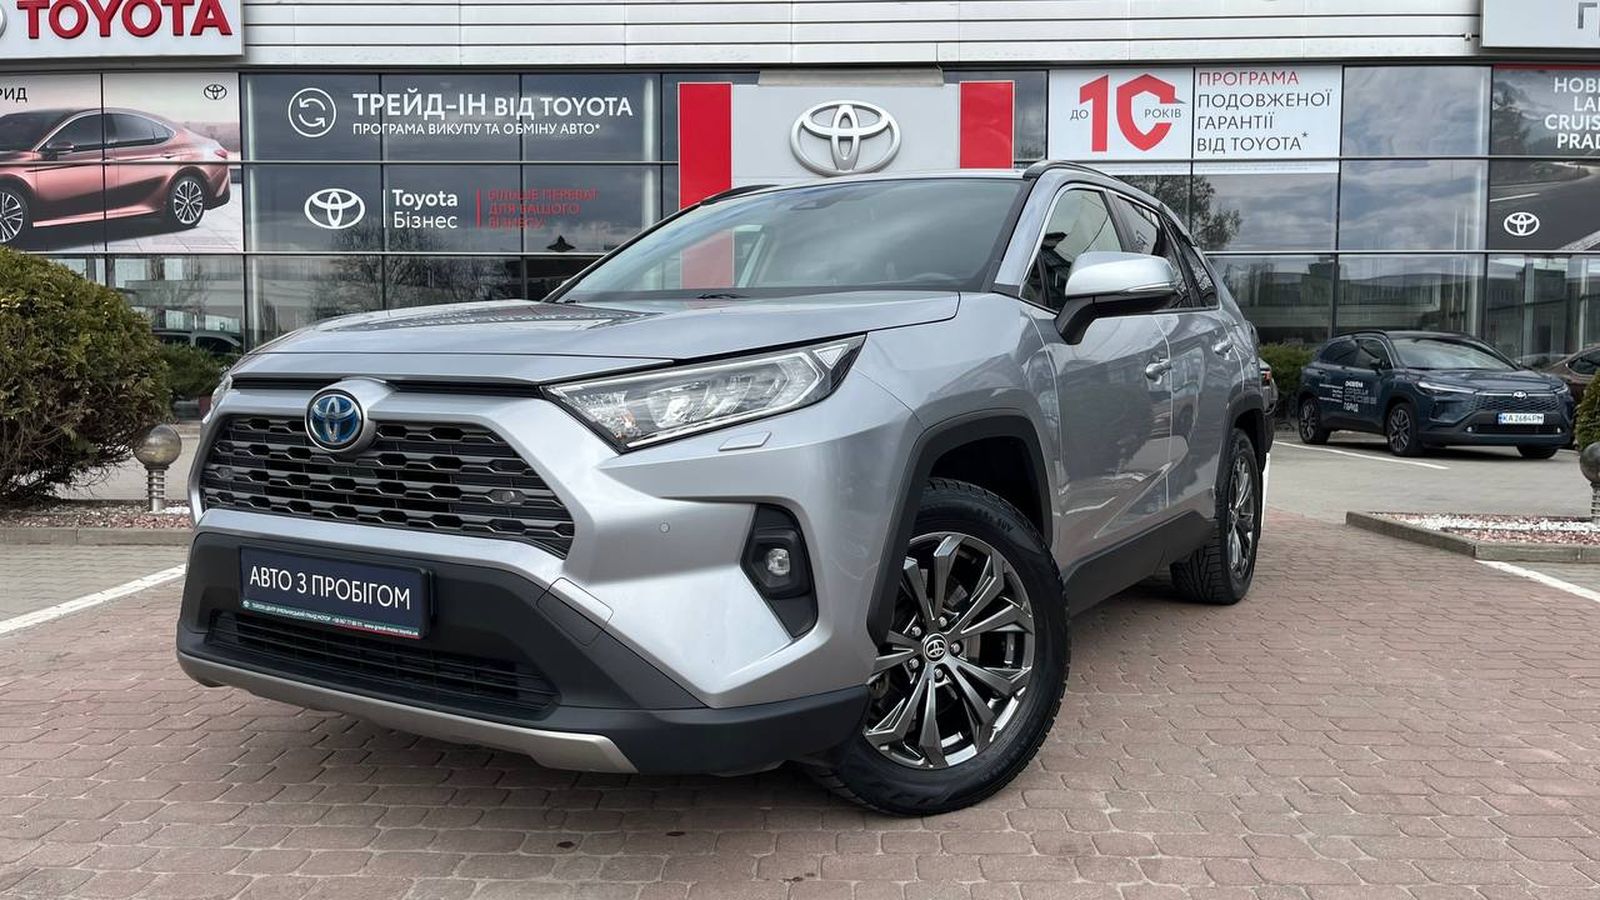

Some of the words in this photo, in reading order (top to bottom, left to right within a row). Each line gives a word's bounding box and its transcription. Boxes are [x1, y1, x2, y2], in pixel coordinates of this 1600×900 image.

[17, 0, 233, 39] TOYOTA
[1199, 71, 1299, 86] ПРОГРАМА
[1554, 77, 1600, 93] НОВ
[352, 87, 486, 120] ТРЕЙД-ІН
[495, 97, 535, 120] ВІД
[540, 97, 633, 117] TOYOTA
[1198, 89, 1332, 110] ПОДОВЖЕНОЇ
[1574, 96, 1600, 112] LA
[1070, 110, 1088, 121] ДО
[1144, 108, 1181, 119] РОКІВ
[1197, 112, 1275, 130] ГАРАНТІЇ
[353, 123, 425, 135] ПРОГРАМА
[428, 123, 482, 135] ВИКУПУ
[484, 123, 499, 135] ТА
[503, 123, 557, 135] ОБМІНУ
[1198, 137, 1225, 154] ВІД
[392, 190, 458, 211] Toyota
[394, 212, 458, 229] Бізнес
[250, 565, 292, 591] АВТО
[297, 573, 307, 594] З
[312, 575, 411, 610] ПРОБІГОМ
